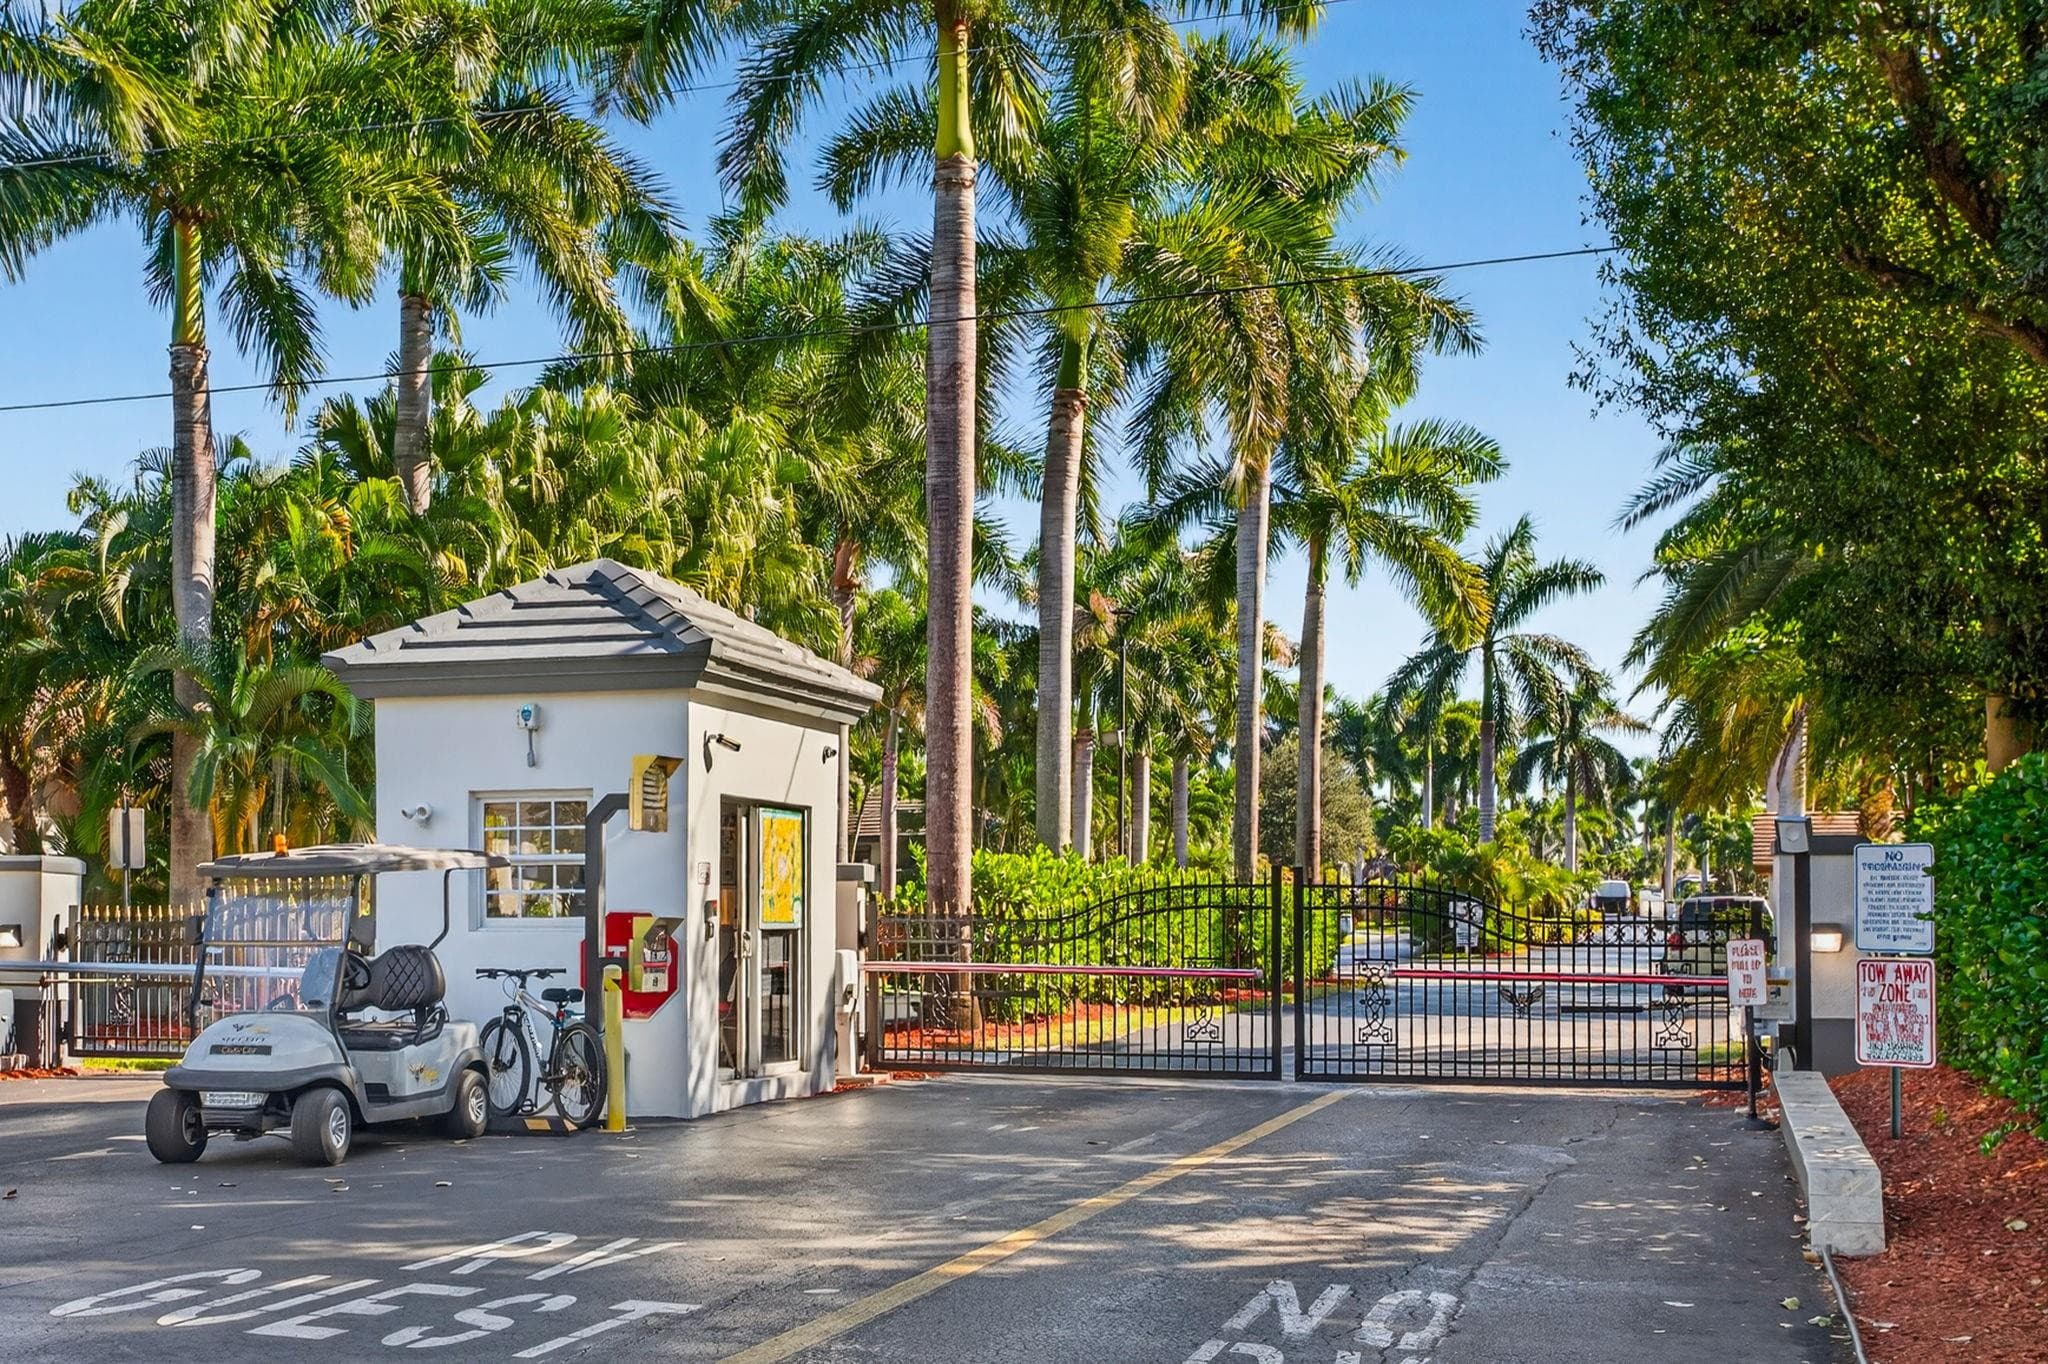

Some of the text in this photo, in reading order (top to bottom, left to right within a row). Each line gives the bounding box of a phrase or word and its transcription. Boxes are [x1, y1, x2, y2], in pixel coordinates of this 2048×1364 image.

[1885, 851, 1903, 861] NO
[1861, 964, 1928, 983] TOW AWAY
[1879, 983, 1911, 1002] ZONE
[48, 1267, 703, 1358] GUEST
[1220, 1279, 1462, 1350] NO
